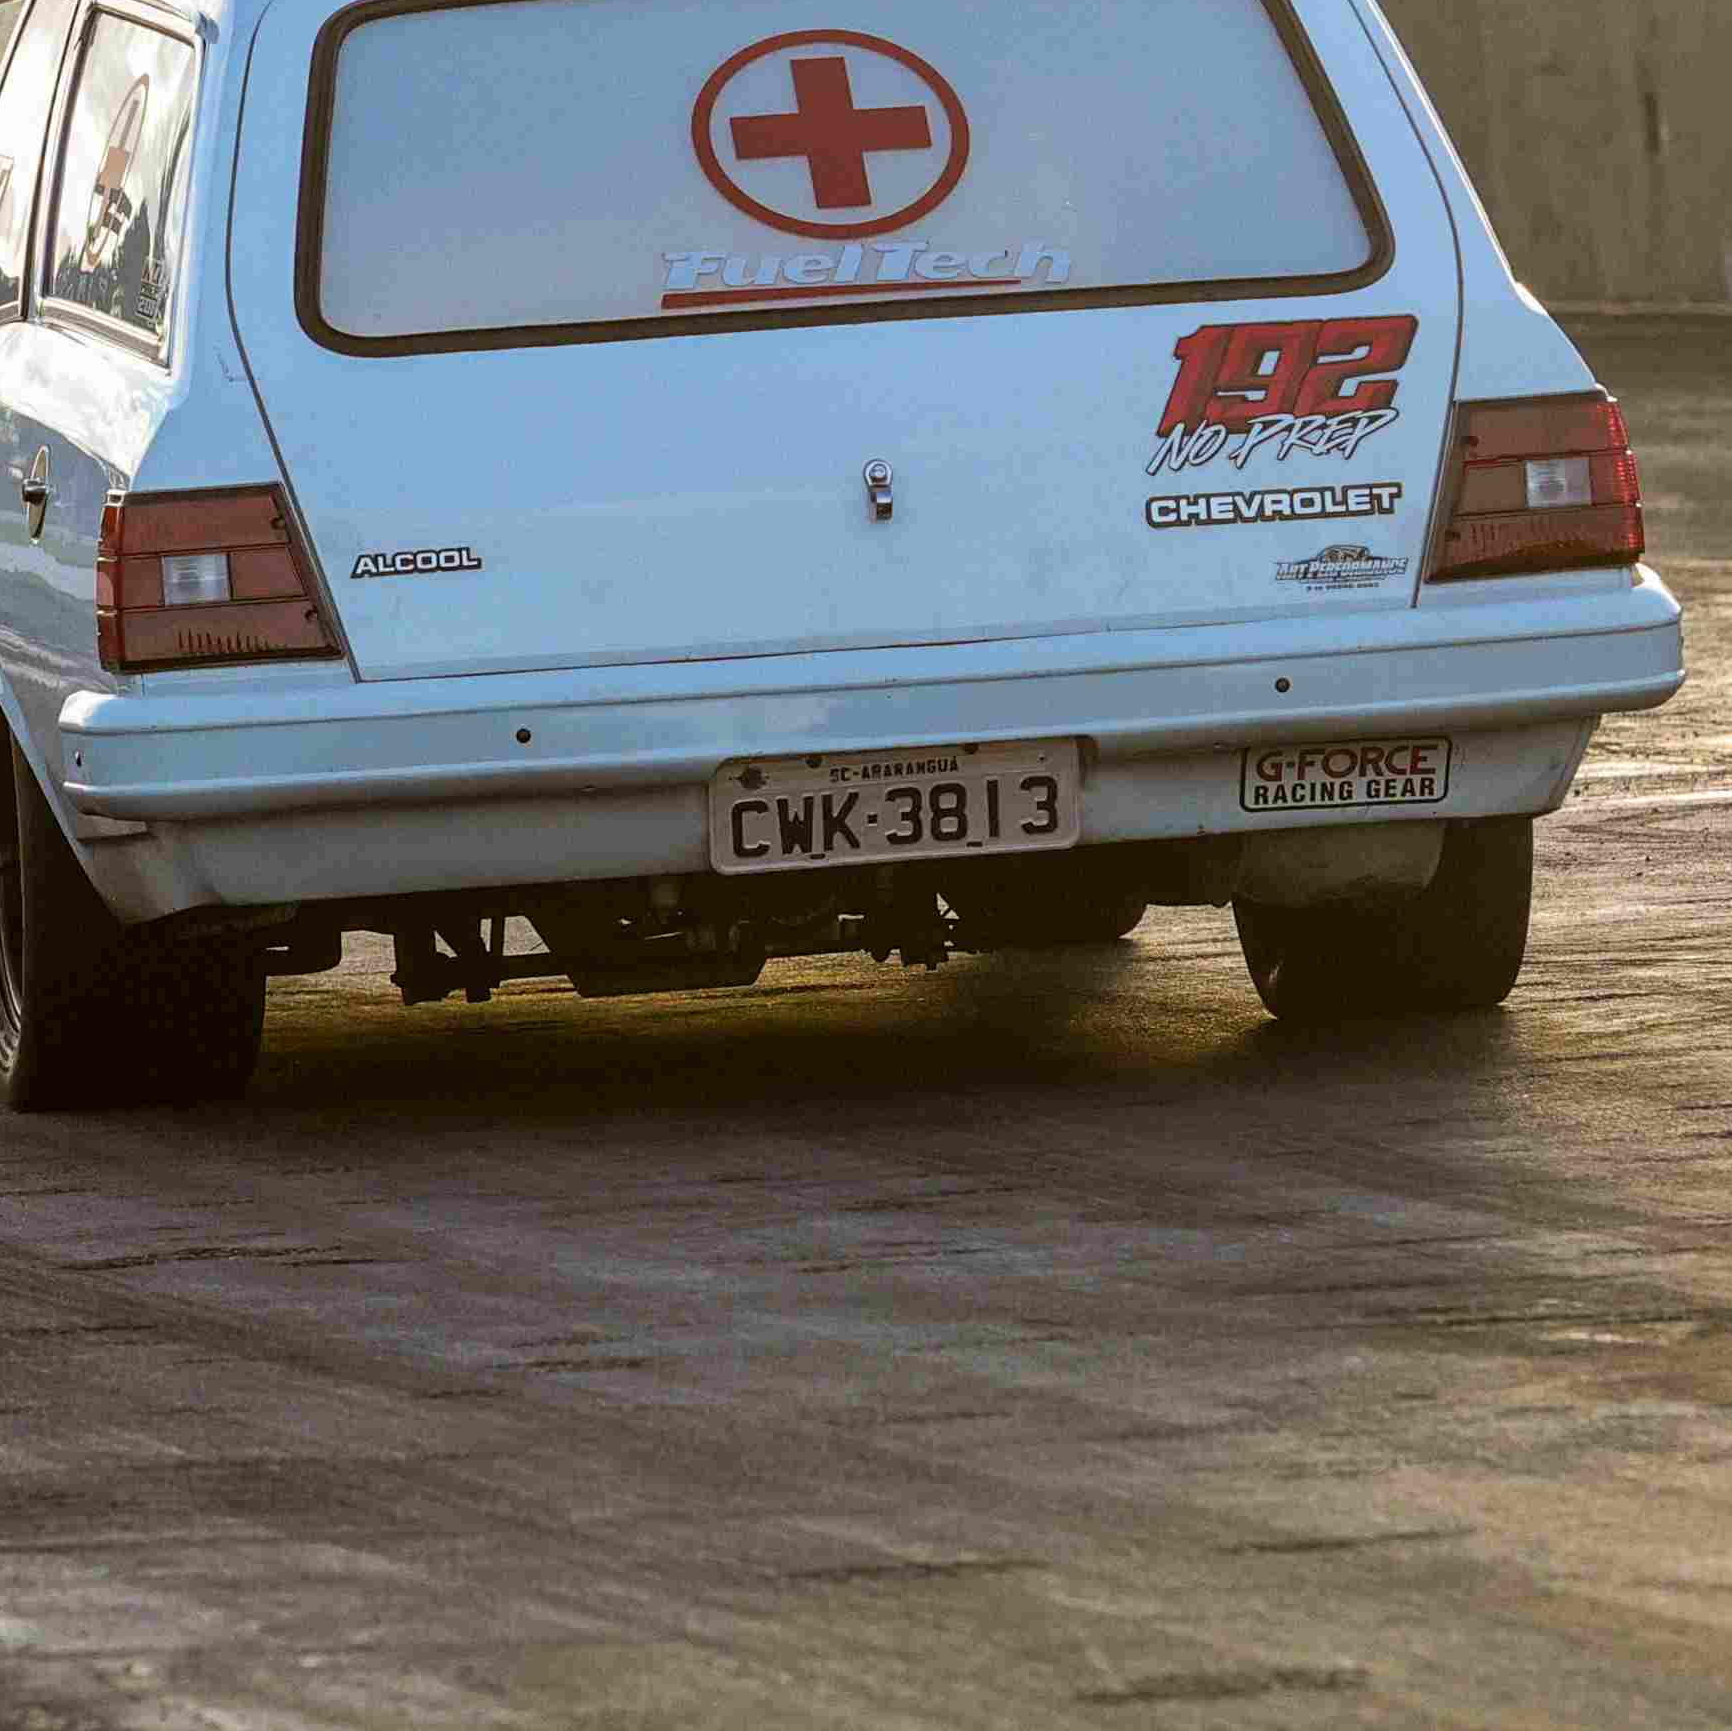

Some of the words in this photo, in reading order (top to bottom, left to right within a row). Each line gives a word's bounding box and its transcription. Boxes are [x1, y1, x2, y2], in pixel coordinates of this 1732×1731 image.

[660, 240, 1072, 290] FuelTech
[1157, 315, 1418, 436] 192
[1145, 421, 1228, 475] NO
[1230, 408, 1399, 468] PREP
[1149, 485, 1401, 525] CHEVROLET
[353, 548, 480, 577] ALCOOL
[1253, 781, 1354, 805] RACING
[1366, 777, 1436, 800] GEAR
